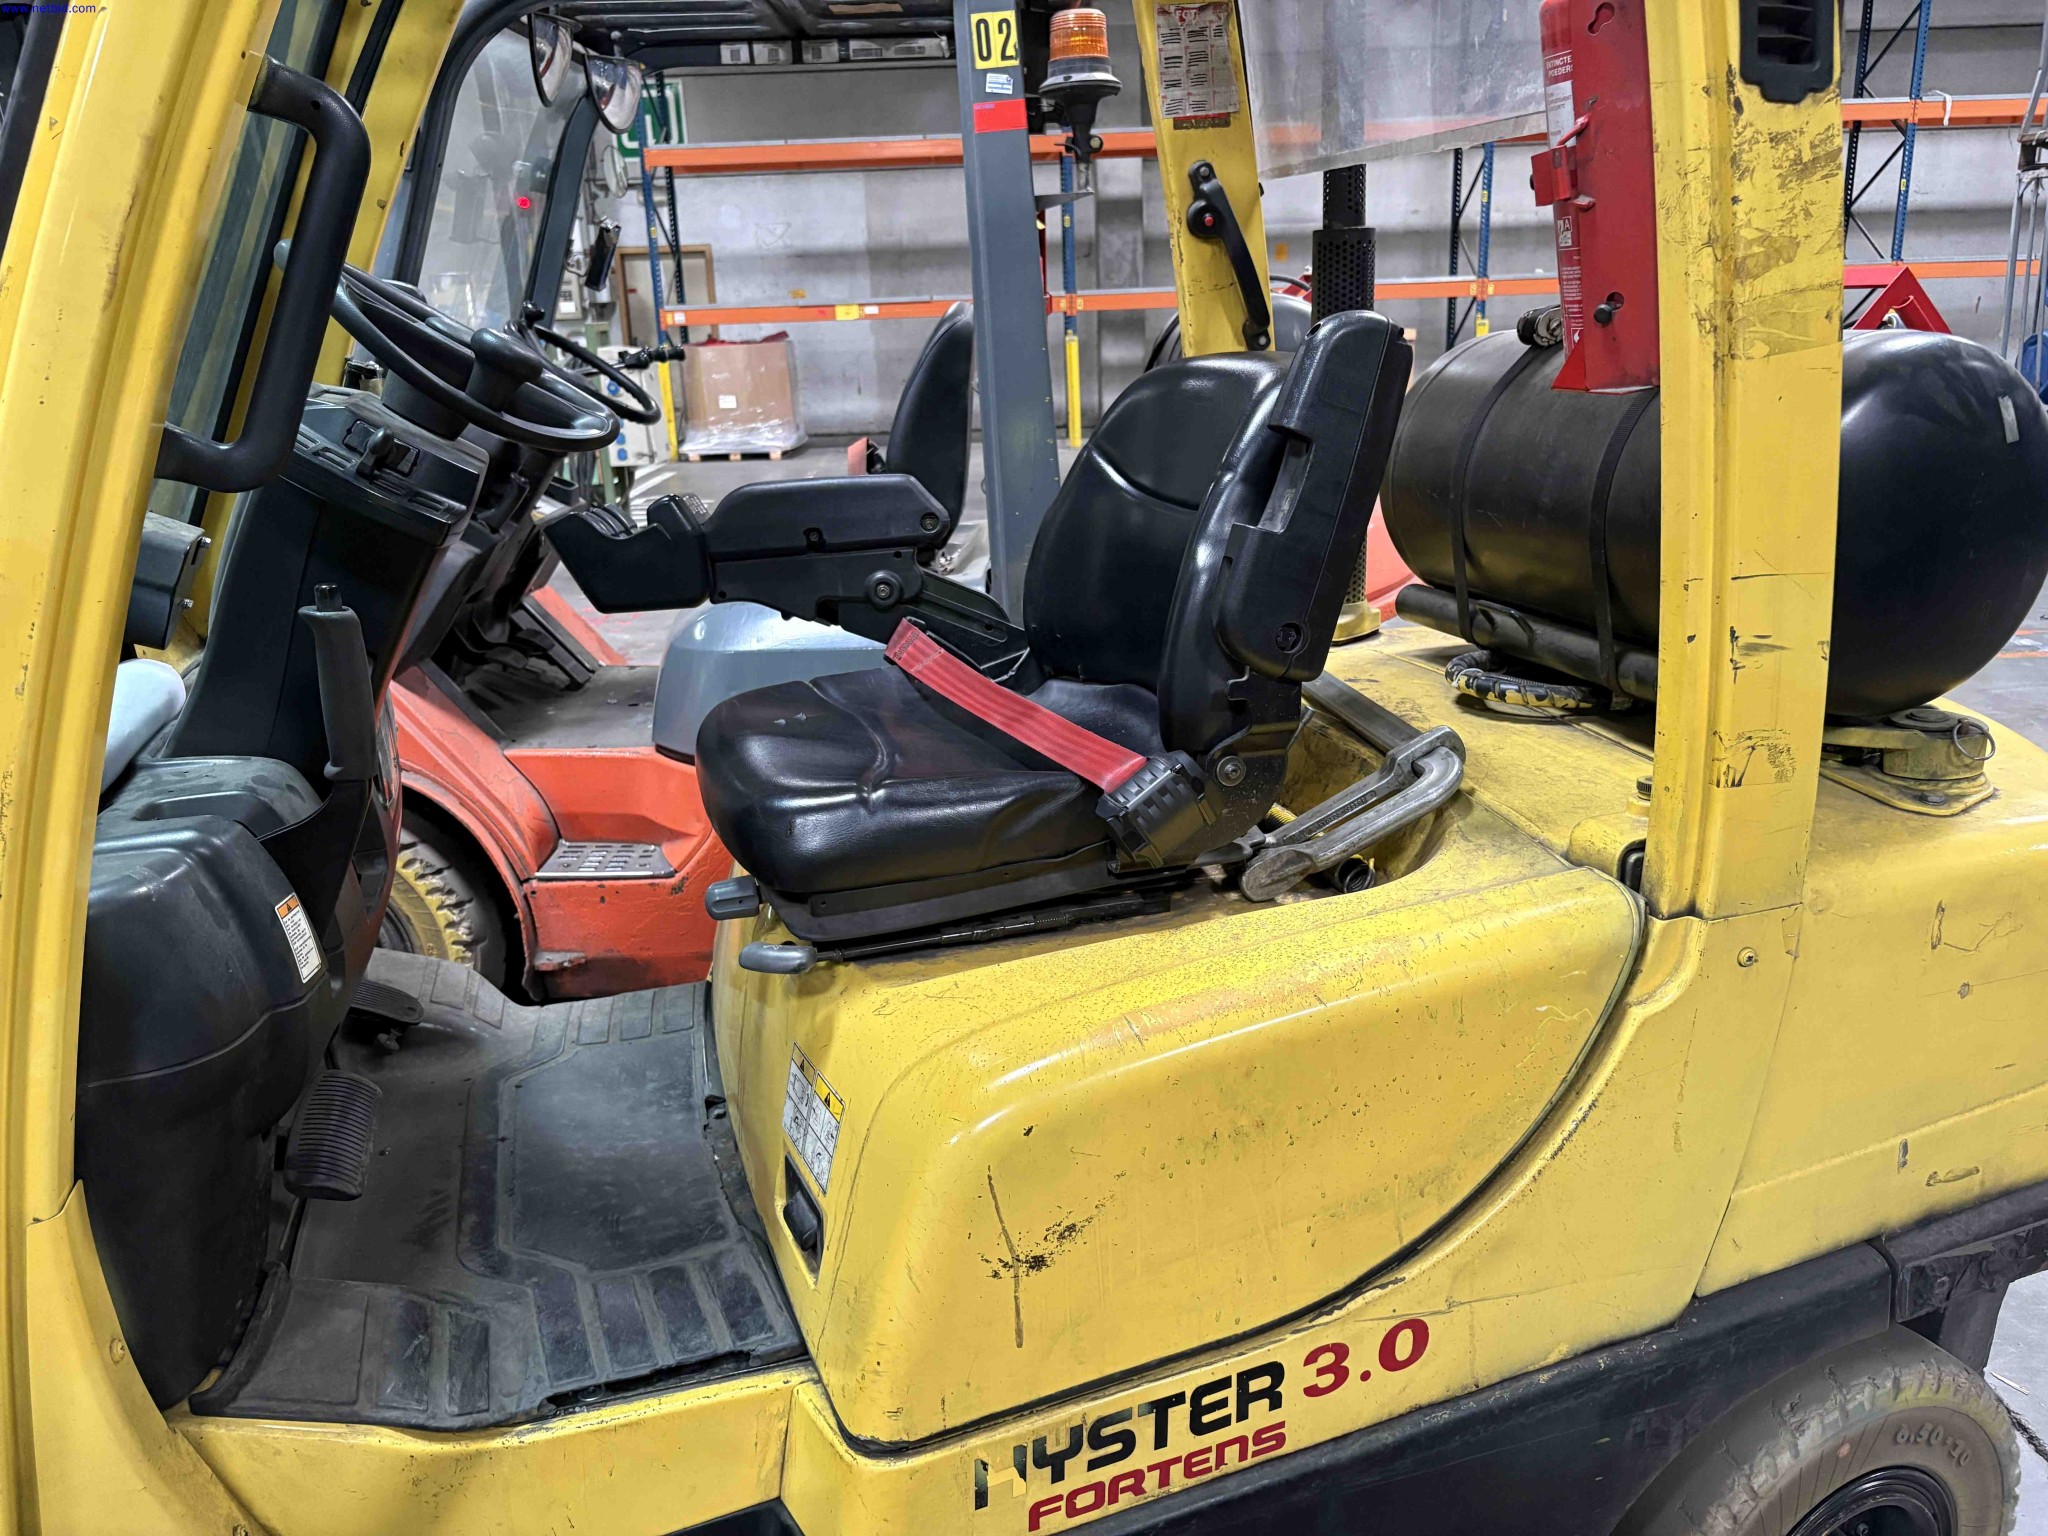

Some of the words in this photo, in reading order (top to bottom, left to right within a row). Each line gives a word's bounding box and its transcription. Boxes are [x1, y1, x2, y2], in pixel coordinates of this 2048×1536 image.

[975, 17, 1018, 62] 02
[974, 1360, 1285, 1511] HYSTER
[1302, 1318, 1430, 1398] 3.0
[1028, 1420, 1286, 1532] FORTENS
